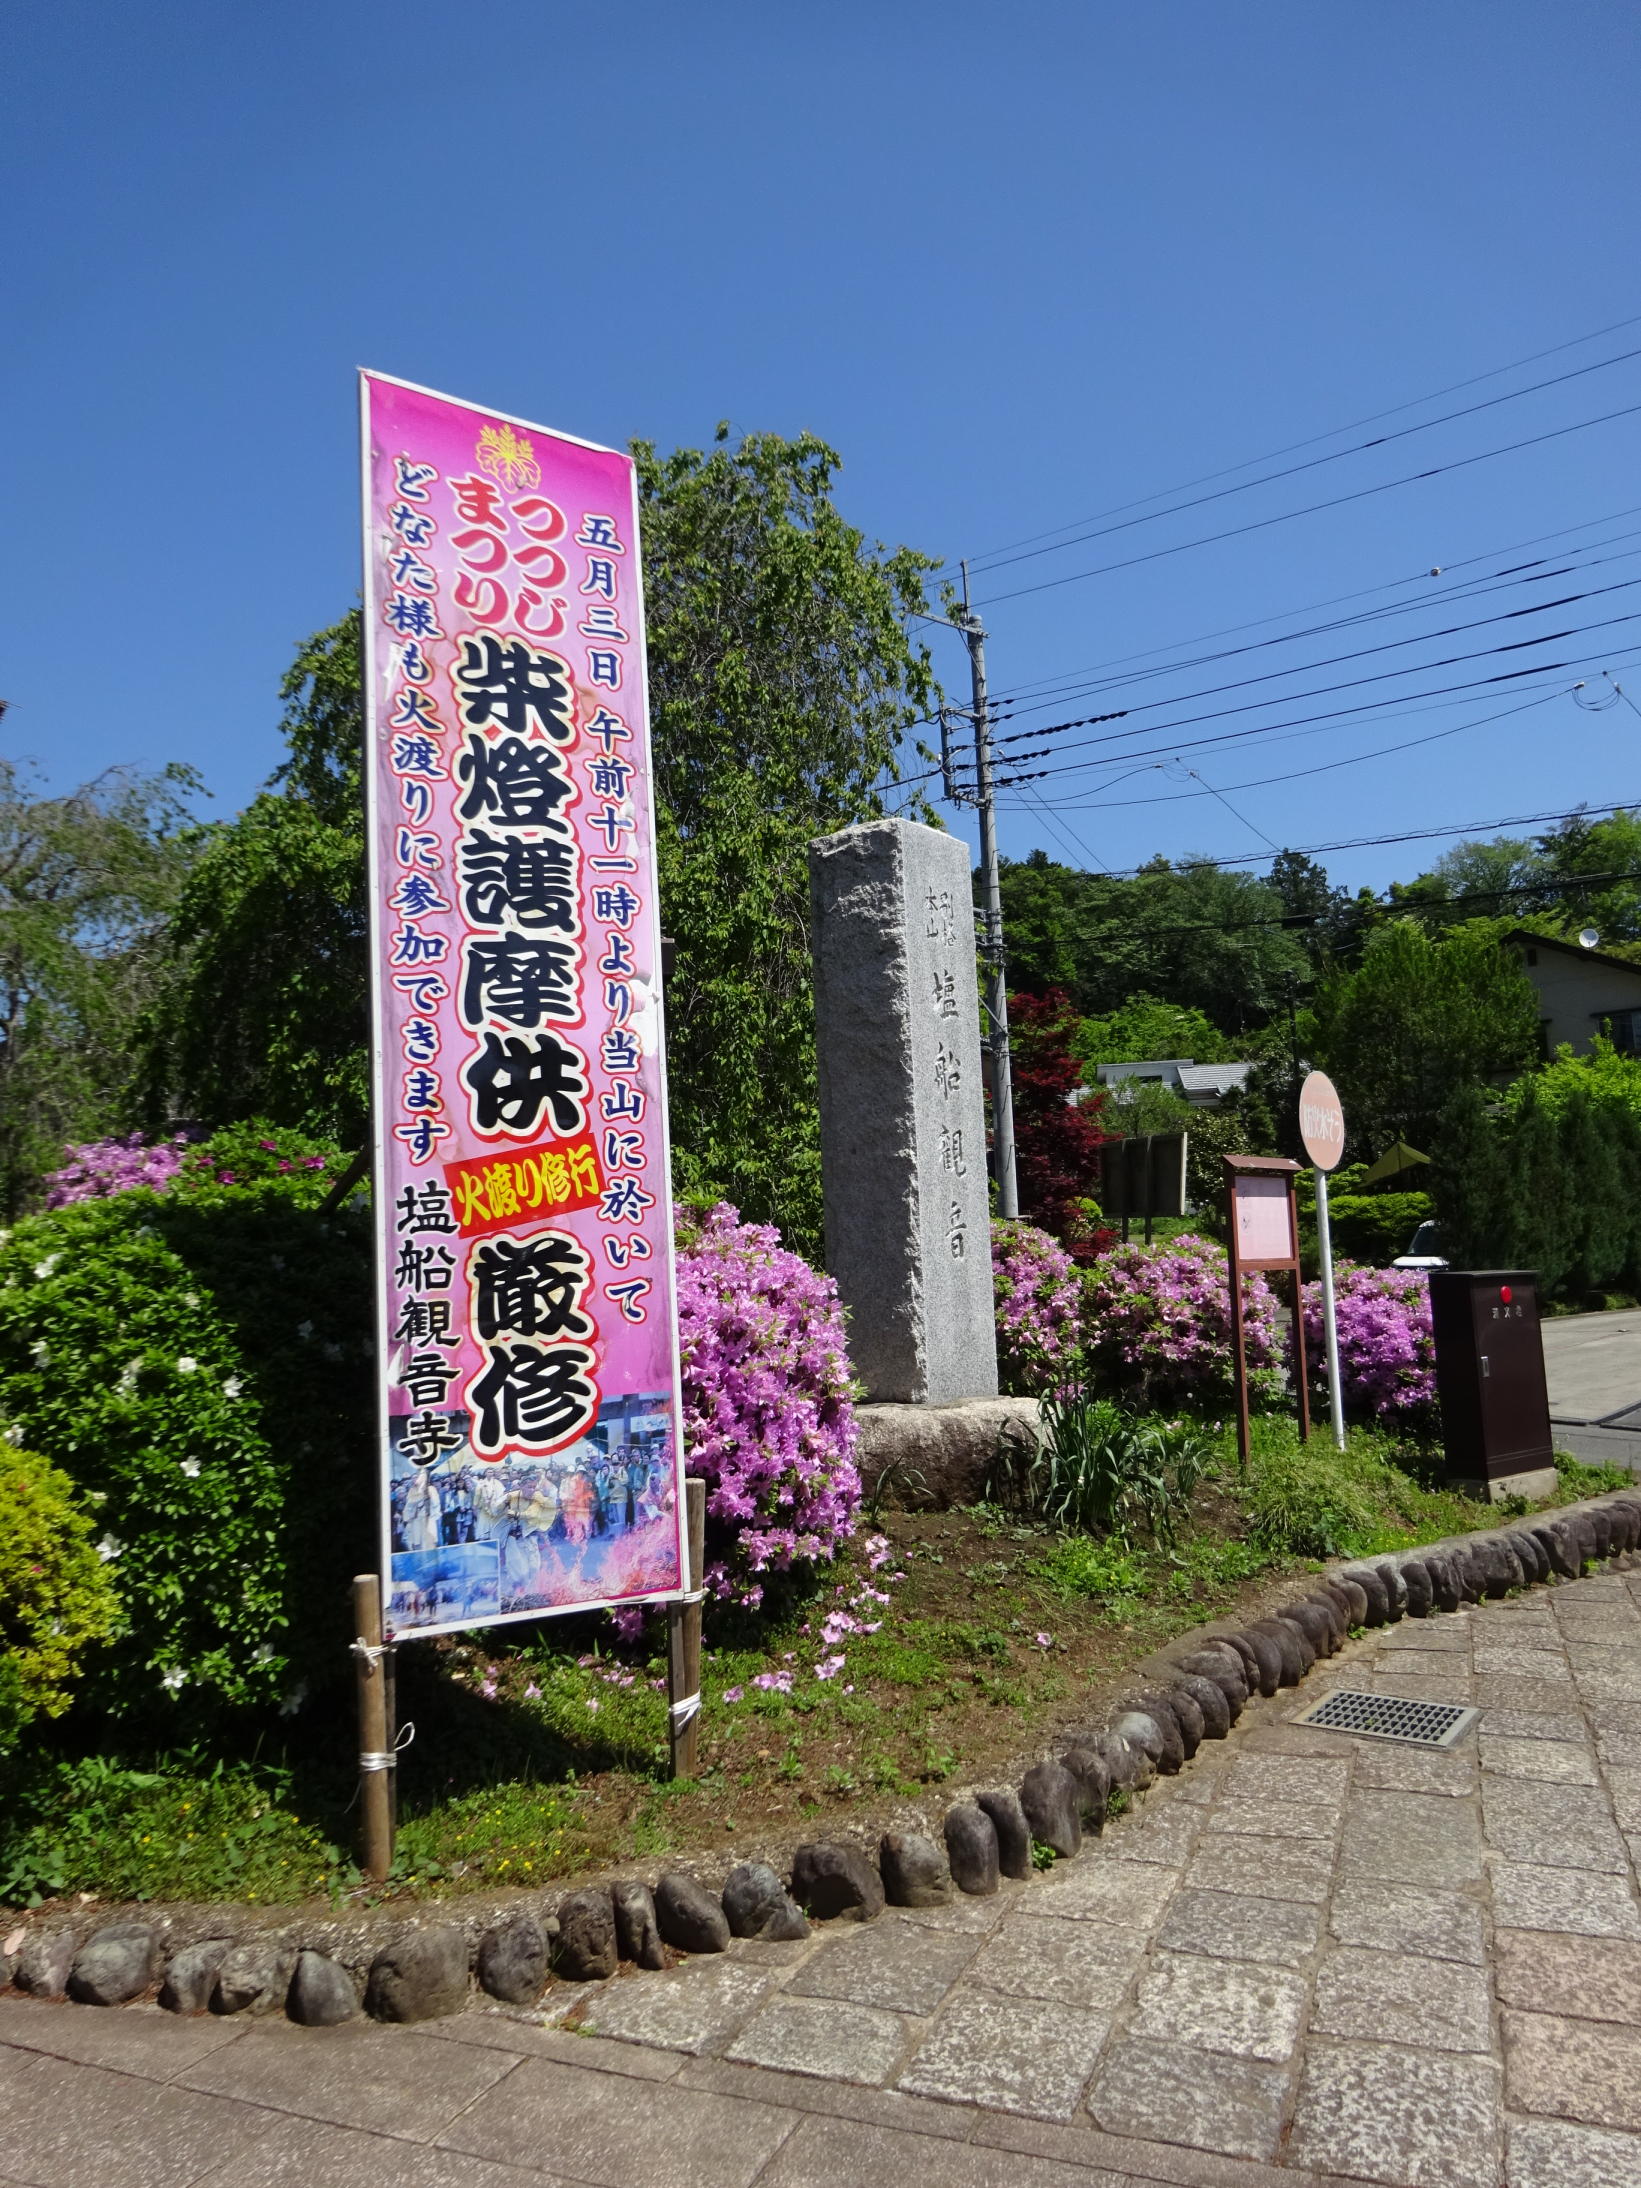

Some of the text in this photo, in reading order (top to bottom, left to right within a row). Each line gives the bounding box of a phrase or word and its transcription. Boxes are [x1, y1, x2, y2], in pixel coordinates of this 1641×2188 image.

[449, 474, 509, 627] まつり
[510, 497, 567, 637] つつじ
[389, 457, 450, 1164] どなた様も火渡りに参加できます
[455, 1144, 601, 1226] 火渡り修行
[395, 1181, 461, 1466] 塩船観音寺
[471, 1238, 591, 1449] 厳修
